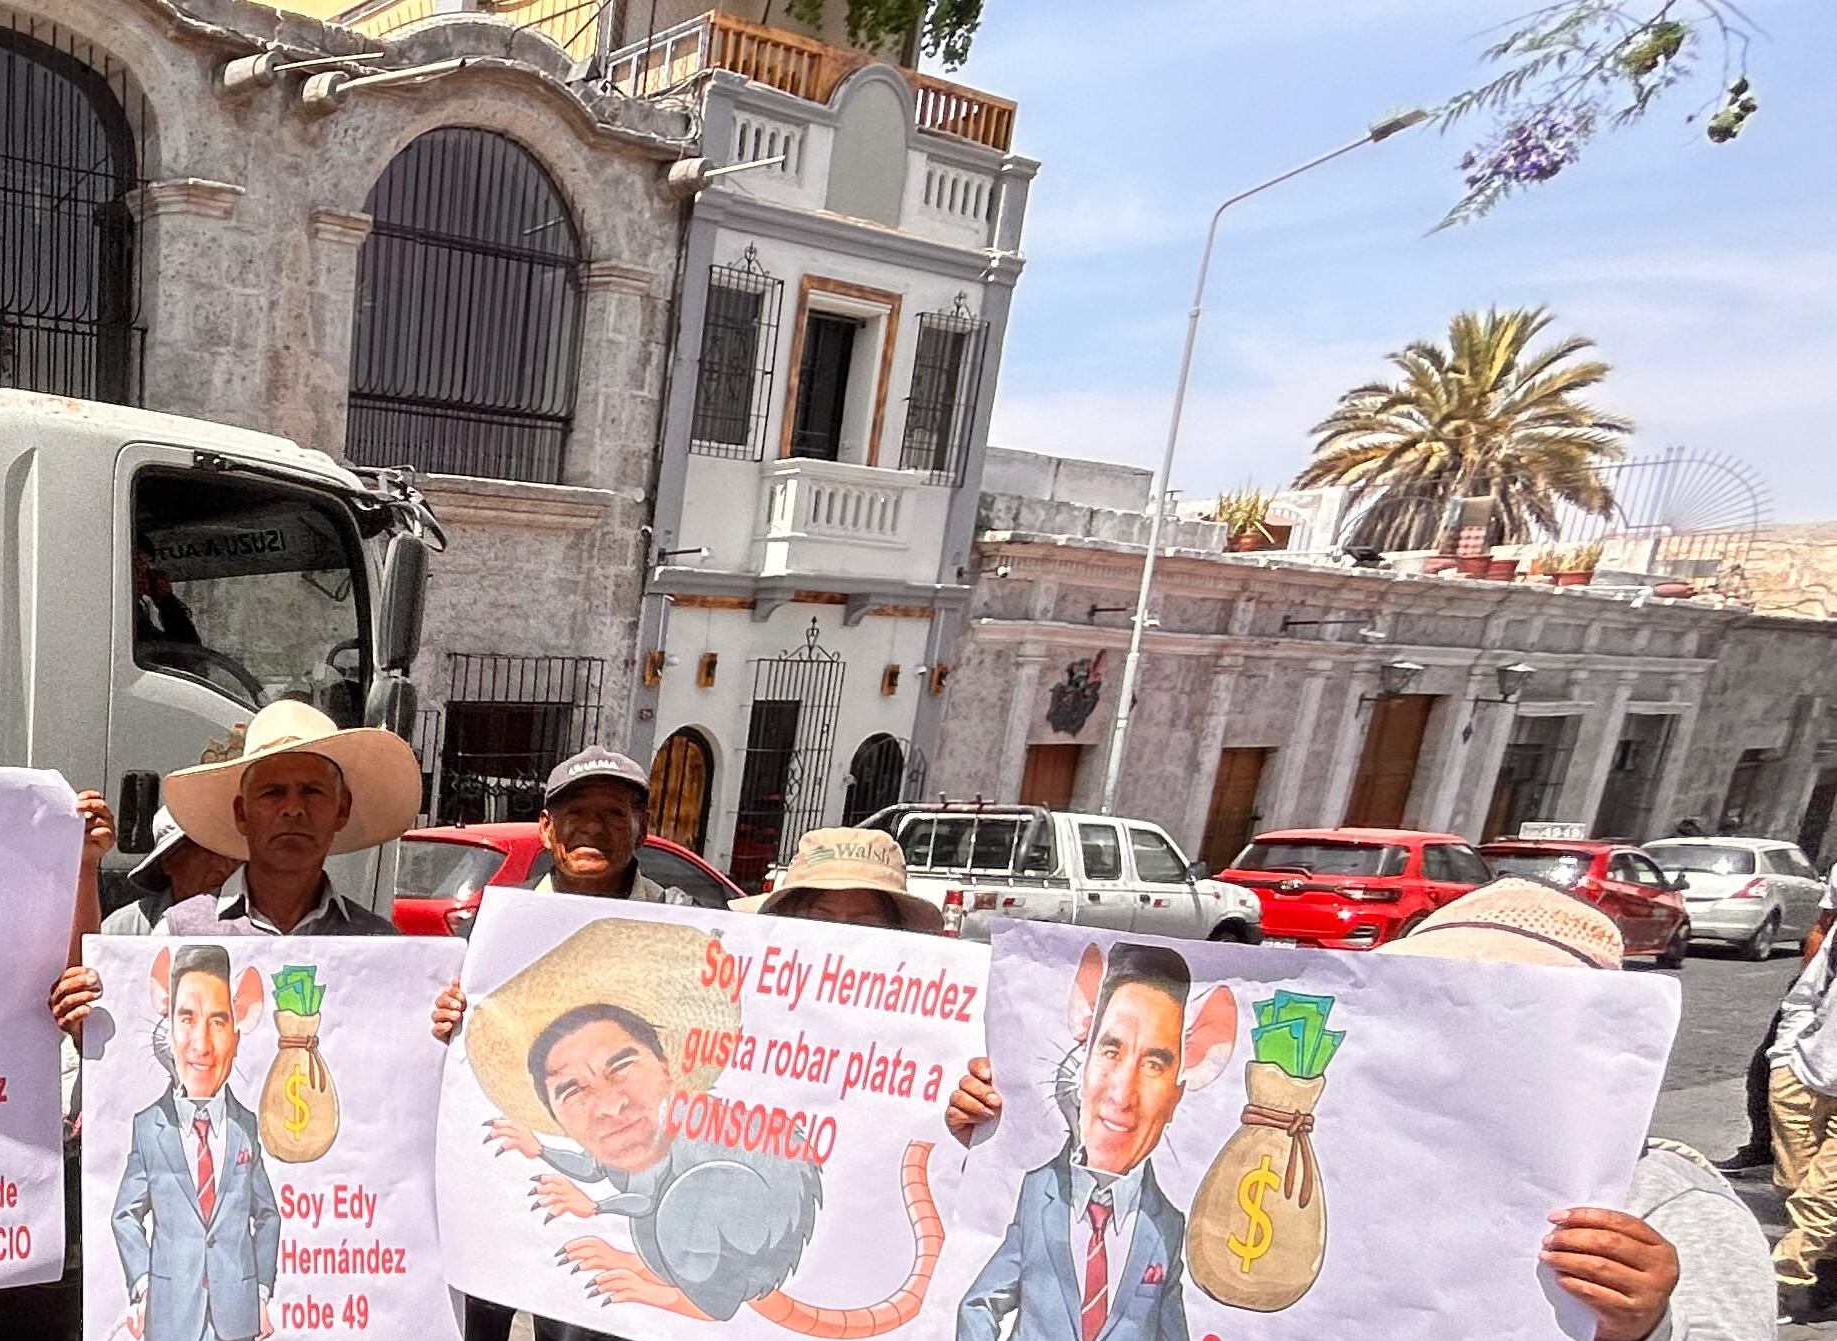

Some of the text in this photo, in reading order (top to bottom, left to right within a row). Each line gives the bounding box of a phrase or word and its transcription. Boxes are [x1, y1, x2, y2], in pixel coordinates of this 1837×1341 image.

[700, 939, 978, 1022] Soy Edy Hernández
[681, 1024, 944, 1103] gusta robar plata a
[665, 1089, 838, 1166] CONSORCIO
[280, 1184, 378, 1228] Soy Edy
[281, 1239, 407, 1275] Hernández
[281, 1294, 369, 1330] robe 49
